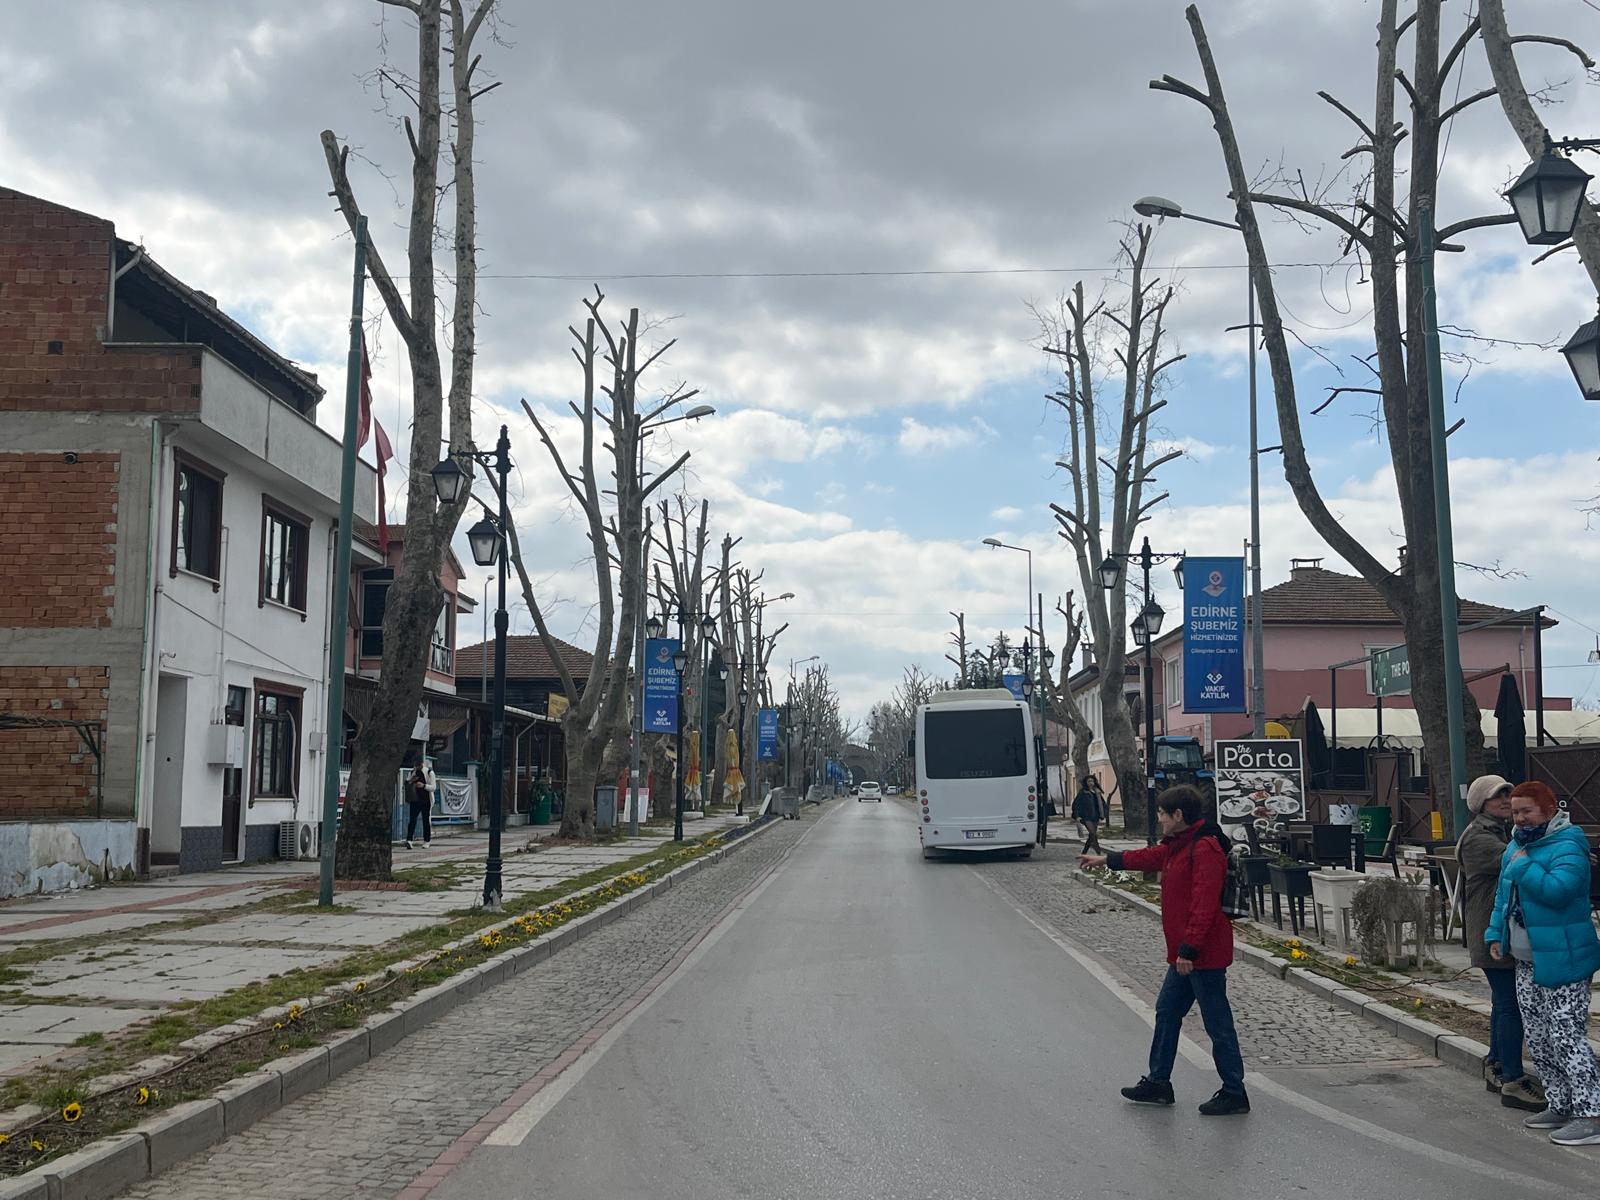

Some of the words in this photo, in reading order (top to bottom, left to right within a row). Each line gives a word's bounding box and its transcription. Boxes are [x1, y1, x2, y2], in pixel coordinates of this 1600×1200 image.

[1191, 604, 1238, 617] EDİRNE
[1190, 619, 1238, 632] ŞUBEMİZ
[1190, 633, 1239, 641] HİZMETİNİZDE
[648, 667, 677, 676] EDİRNE
[1391, 663, 1401, 678] THE
[1204, 685, 1226, 693] VAKIF
[1200, 692, 1230, 700] KATILIM
[1237, 744, 1252, 754] the
[1224, 747, 1294, 768] Porta
